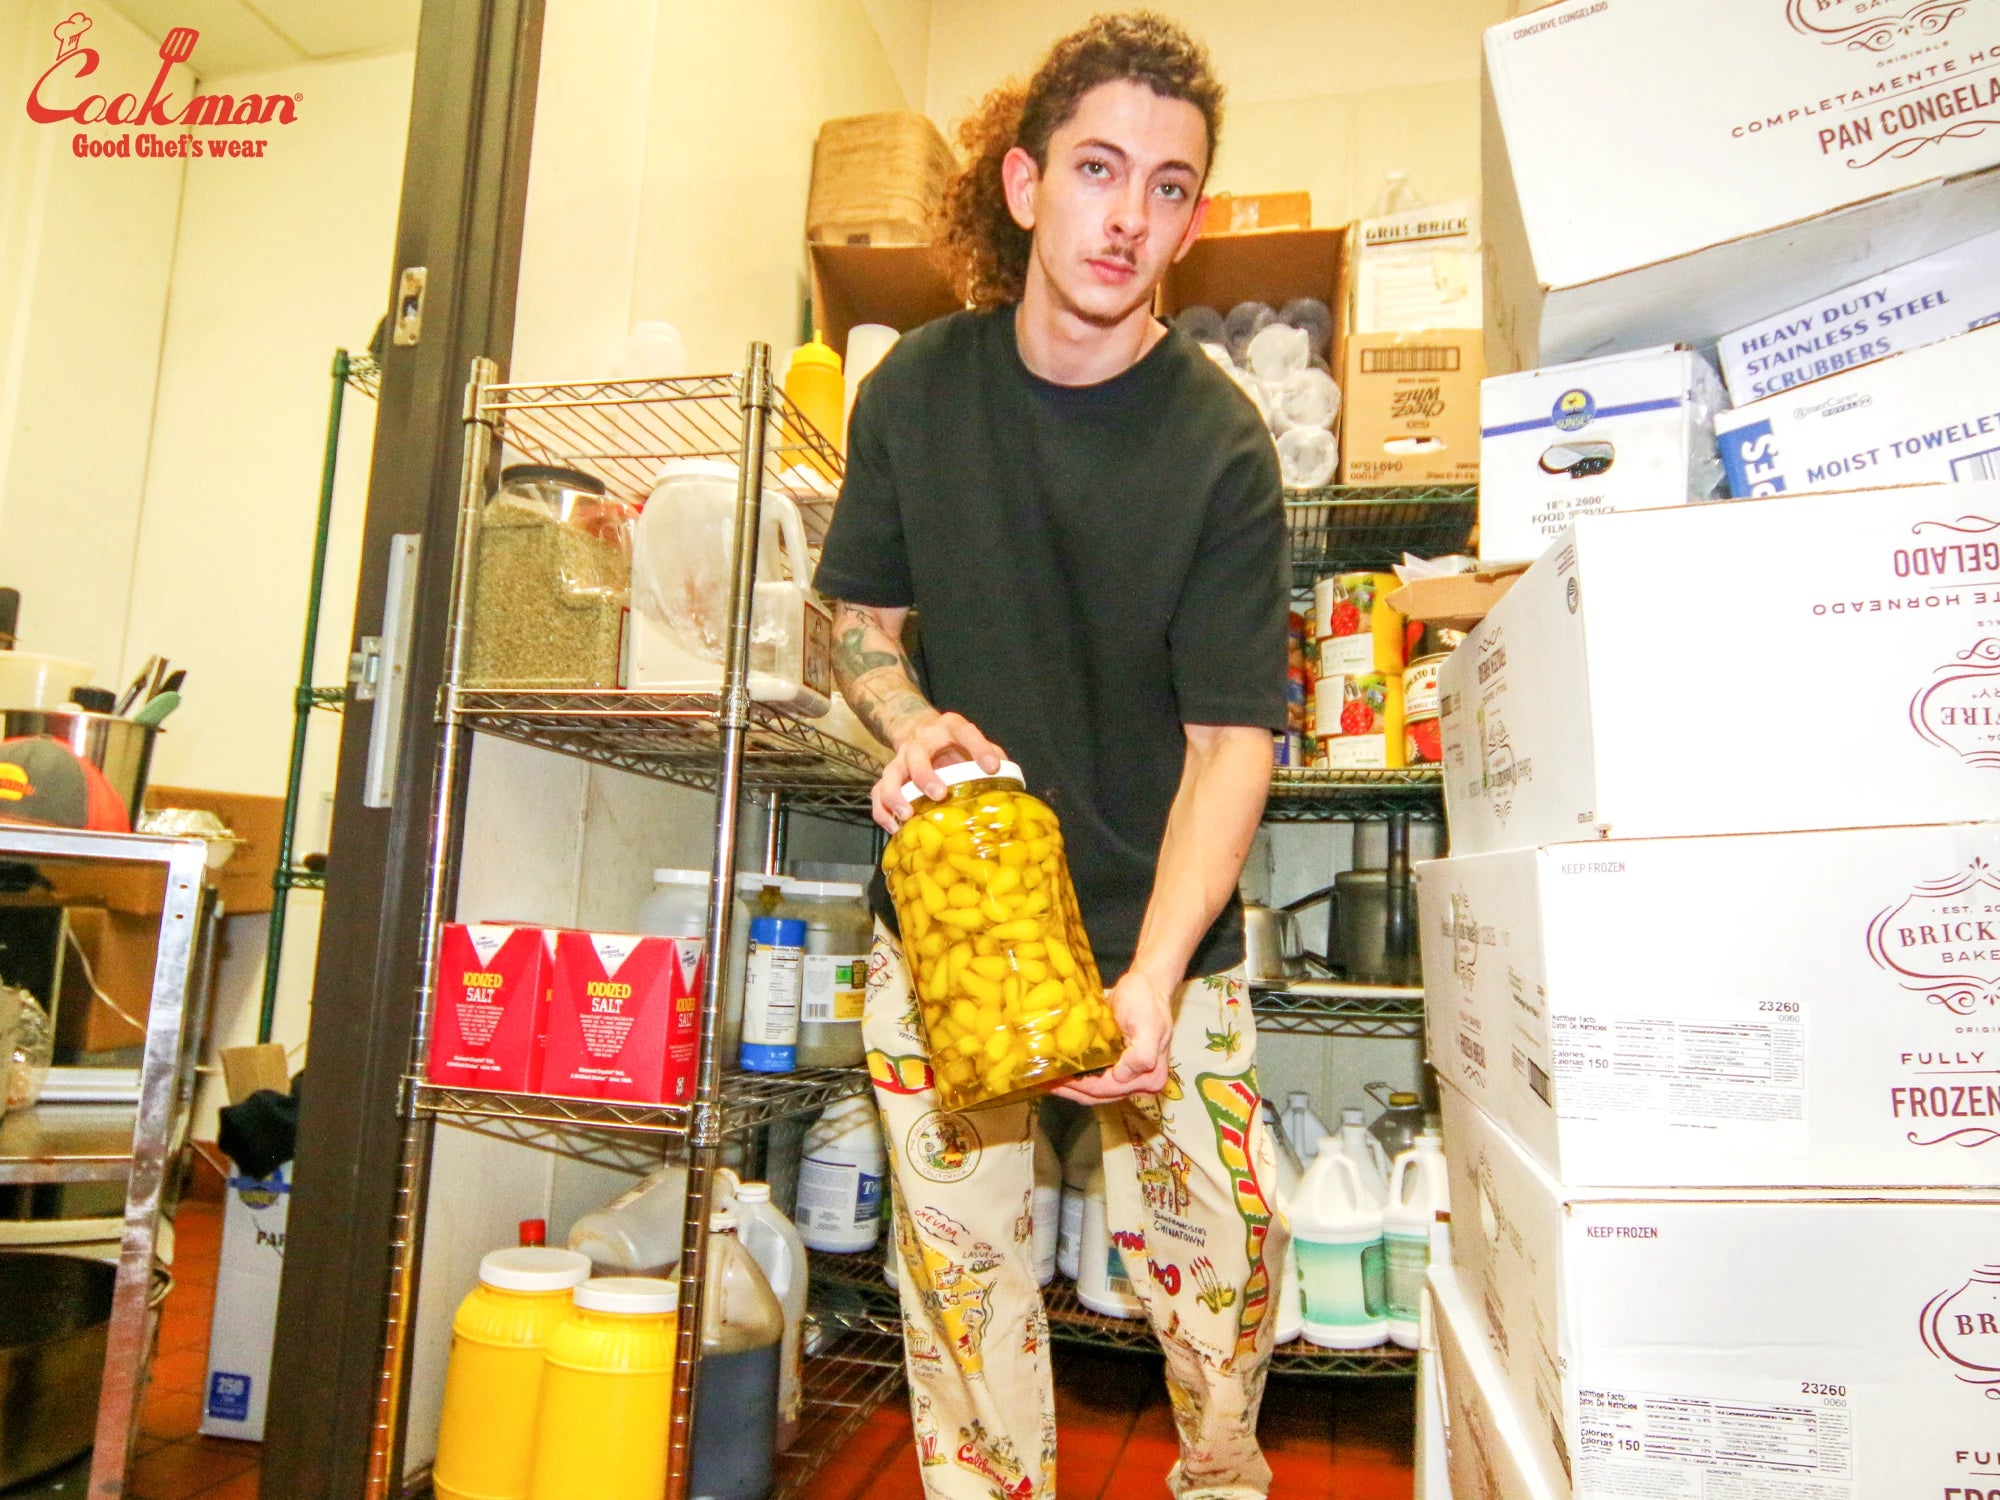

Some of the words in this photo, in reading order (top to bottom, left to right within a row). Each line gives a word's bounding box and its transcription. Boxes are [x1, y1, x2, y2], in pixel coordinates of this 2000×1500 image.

[1513, 18, 1557, 40] CONSERVE
[1558, 1, 1609, 25] CONGELADO
[1731, 60, 1957, 138] COMPLETAMENTE
[1818, 116, 1873, 155] PAN
[1742, 315, 1814, 356] HEAVY
[1822, 287, 1888, 325] DUTY
[1746, 319, 1869, 377] STAINLESS
[1877, 289, 1950, 328] STEEL
[1752, 335, 1891, 399] SCRUBBERS
[1806, 448, 1880, 484] MOIST
[1532, 511, 1566, 525] FOOD
[1812, 594, 1961, 616] HORNEADO
[1561, 864, 1586, 875] KEEP
[1588, 861, 1626, 873] FROZEN
[1942, 906, 1974, 914] EST.
[463, 971, 503, 988] IODIZED
[466, 987, 495, 1003] SALT
[587, 981, 632, 999] IODIZED
[591, 997, 624, 1014] SALT
[1759, 1000, 1800, 1013] 23260
[678, 1011, 694, 1028] SALT
[1778, 1014, 1801, 1023] 0060
[1588, 1058, 1609, 1069] 150
[1901, 1051, 1985, 1065] FULLY
[1153, 1219, 1206, 1248] CHINATOWN
[1587, 1225, 1614, 1238] KEEP
[1616, 1226, 1658, 1239] FROZEN
[1607, 1391, 1626, 1401] Facts
[1801, 1382, 1847, 1397] 23260
[1823, 1397, 1848, 1407] 0060
[1580, 1428, 1614, 1439] Calories
[1580, 1436, 1614, 1448] Calorias
[1618, 1440, 1641, 1452] 150
